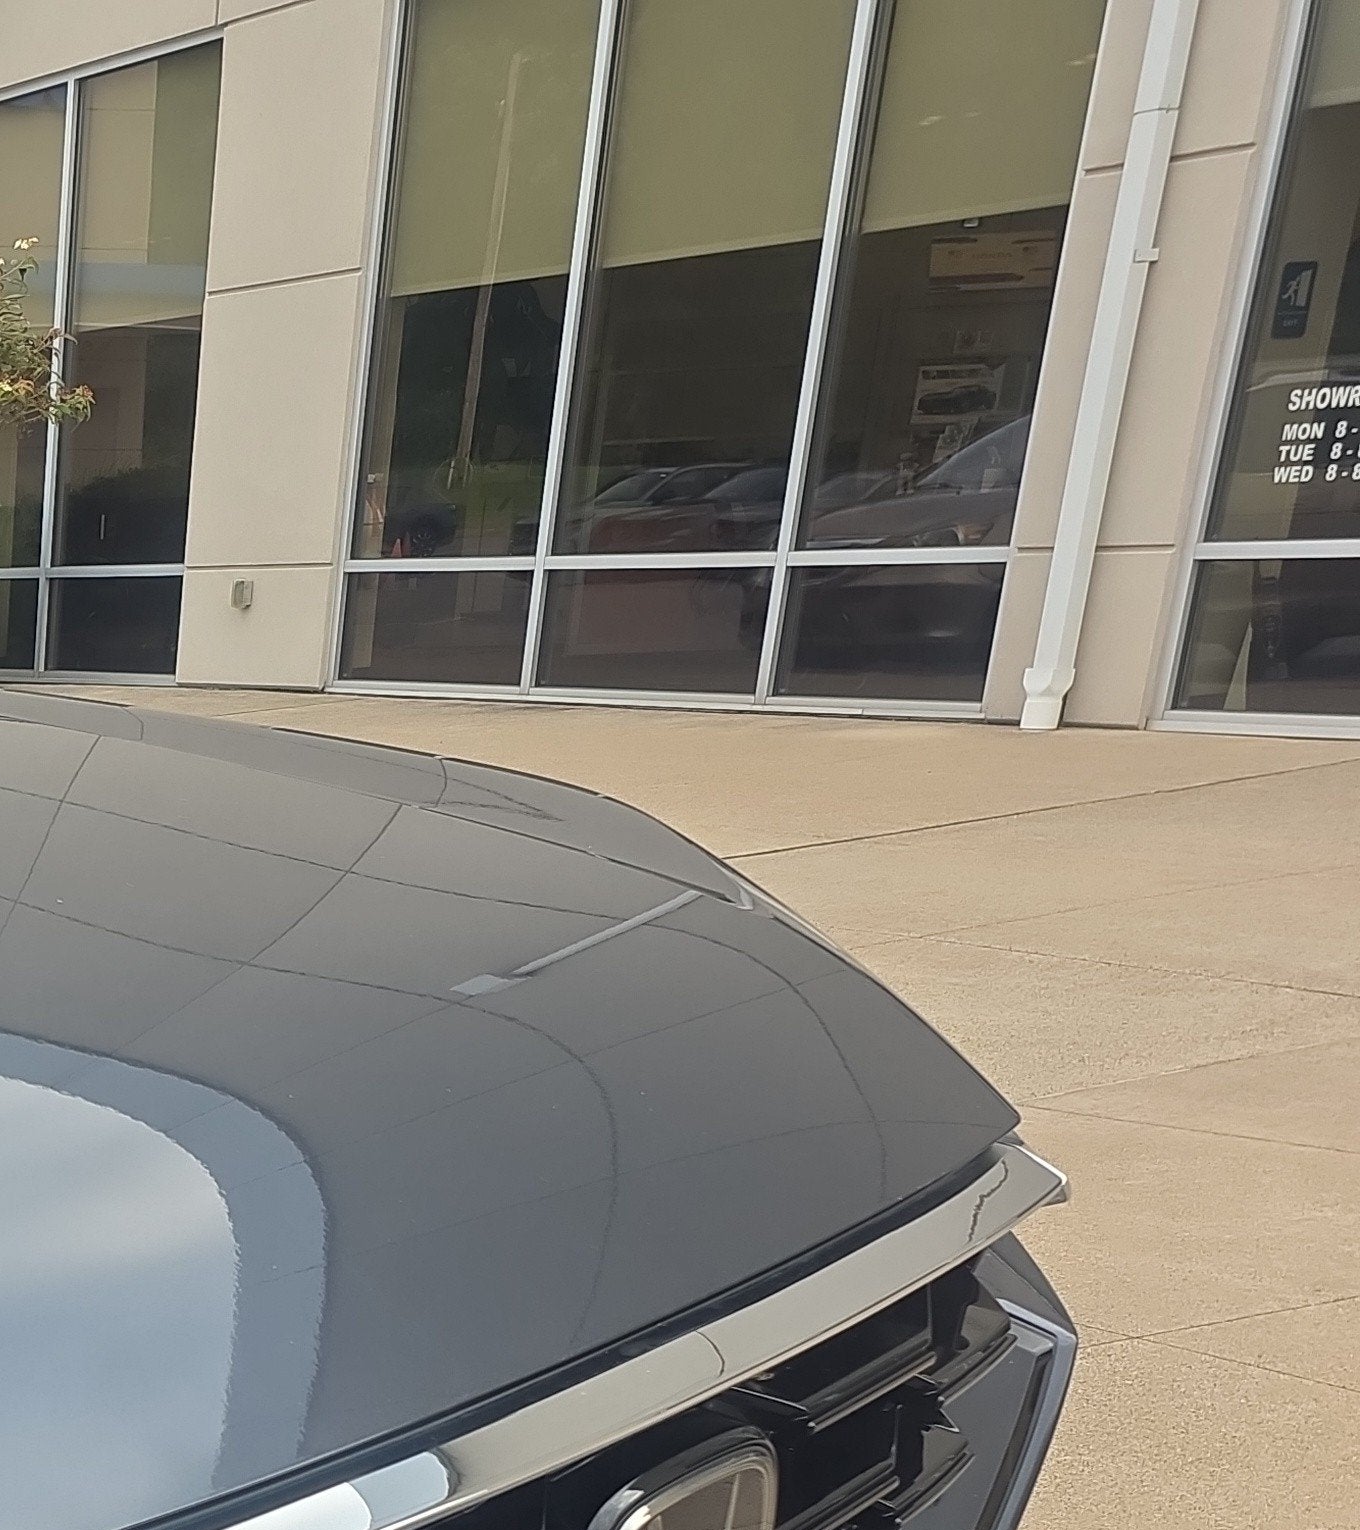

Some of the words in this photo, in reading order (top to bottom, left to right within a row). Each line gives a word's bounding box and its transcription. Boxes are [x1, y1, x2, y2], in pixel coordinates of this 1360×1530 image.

[1282, 422, 1325, 441] MON
[1279, 444, 1316, 462] TUE
[1274, 465, 1313, 483] WED
